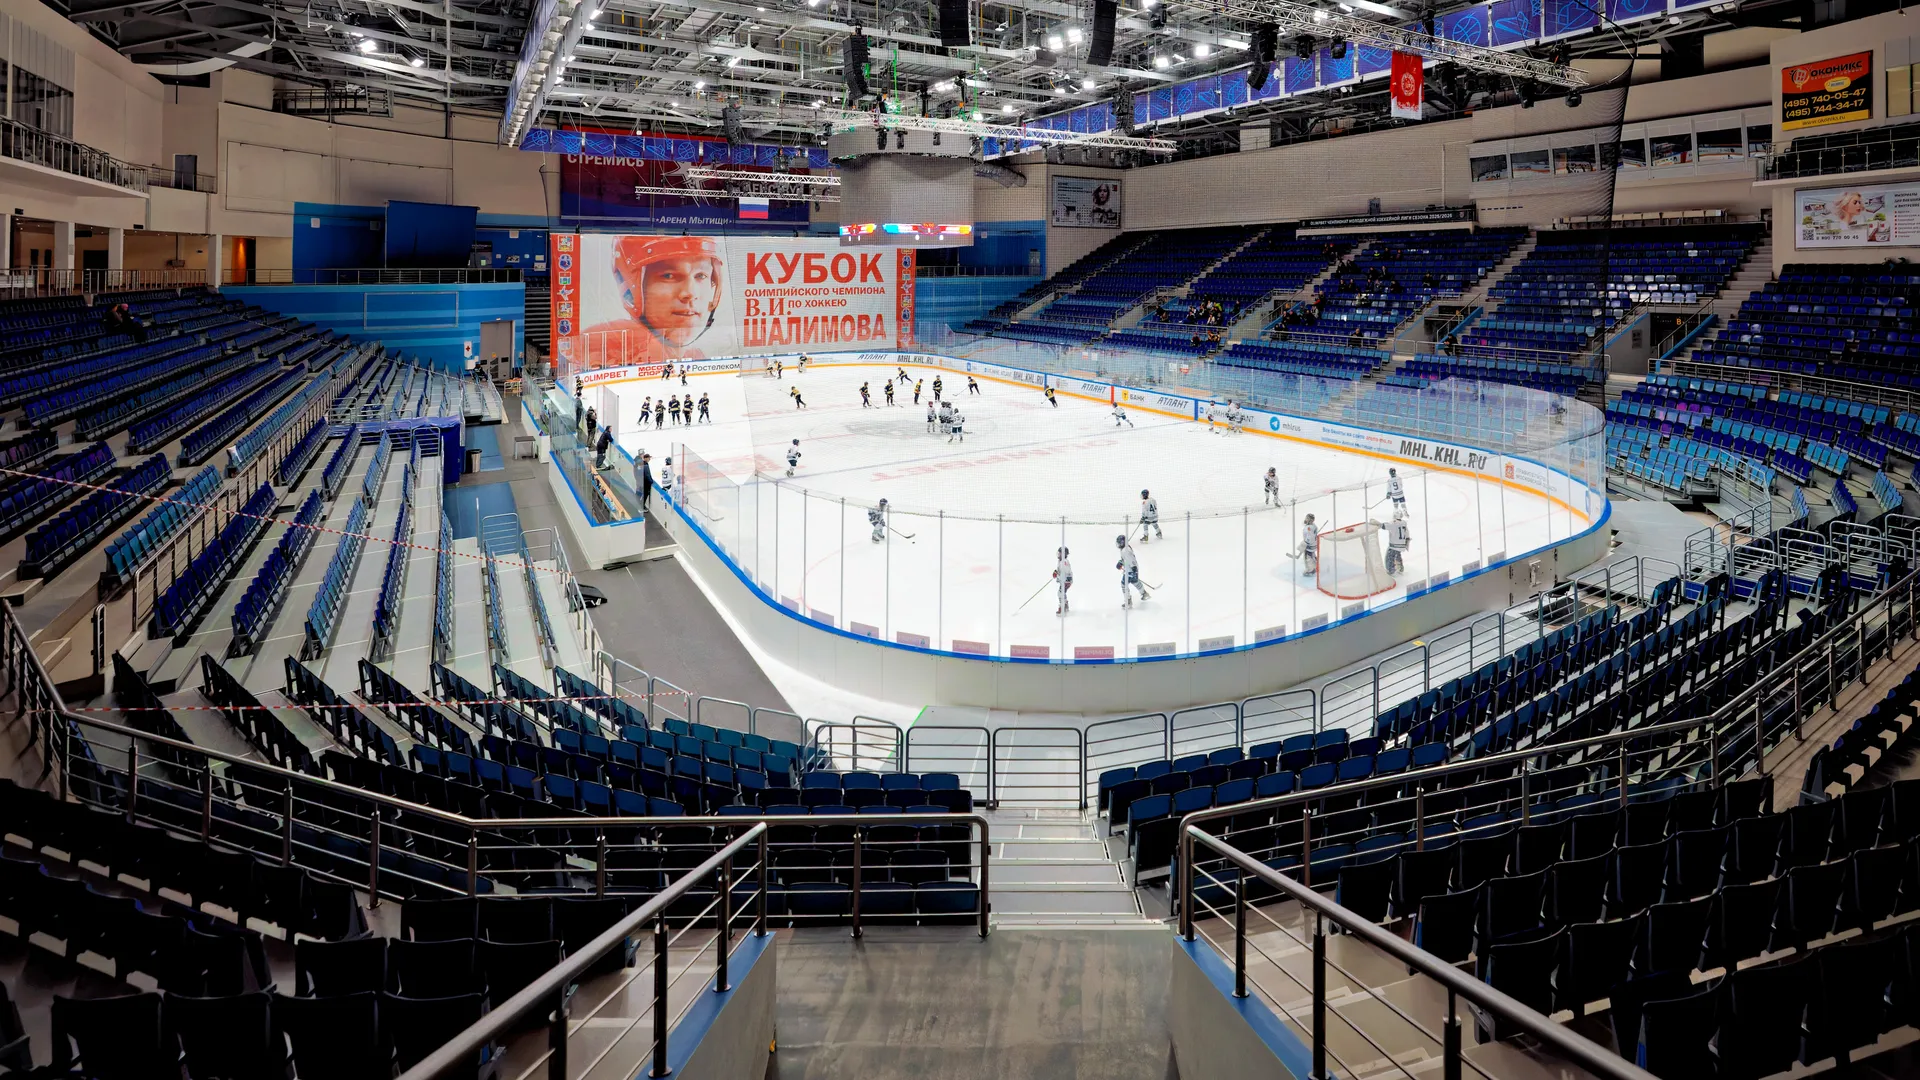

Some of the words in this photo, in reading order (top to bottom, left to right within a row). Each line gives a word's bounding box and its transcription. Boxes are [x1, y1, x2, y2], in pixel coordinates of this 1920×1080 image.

[1810, 60, 1863, 77] ОКОНИКС
[1784, 98, 1809, 109] (495)
[1811, 87, 1867, 104] 740-05-47
[1813, 98, 1865, 114] 744-34-17
[567, 154, 645, 167] СТРЕМИСЬ
[746, 252, 885, 285] КУБОК
[744, 286, 830, 297] ОЛИМПИЙСКОГО
[832, 286, 886, 296] ЧЕМПИОНА
[745, 297, 792, 317] В.И.
[788, 300, 802, 309] ПО
[804, 298, 848, 308] ХОККЕЮ
[743, 313, 887, 347] ШАЛИМОВА
[897, 355, 934, 365] MHL.KHL.RU
[691, 363, 741, 372] Ростелеком
[583, 369, 629, 383] OLIMPBET
[1081, 382, 1107, 394] АТЛАНТ
[1156, 396, 1189, 409] АТЛАНТ
[1400, 440, 1488, 470] MHL.KHL.RU
